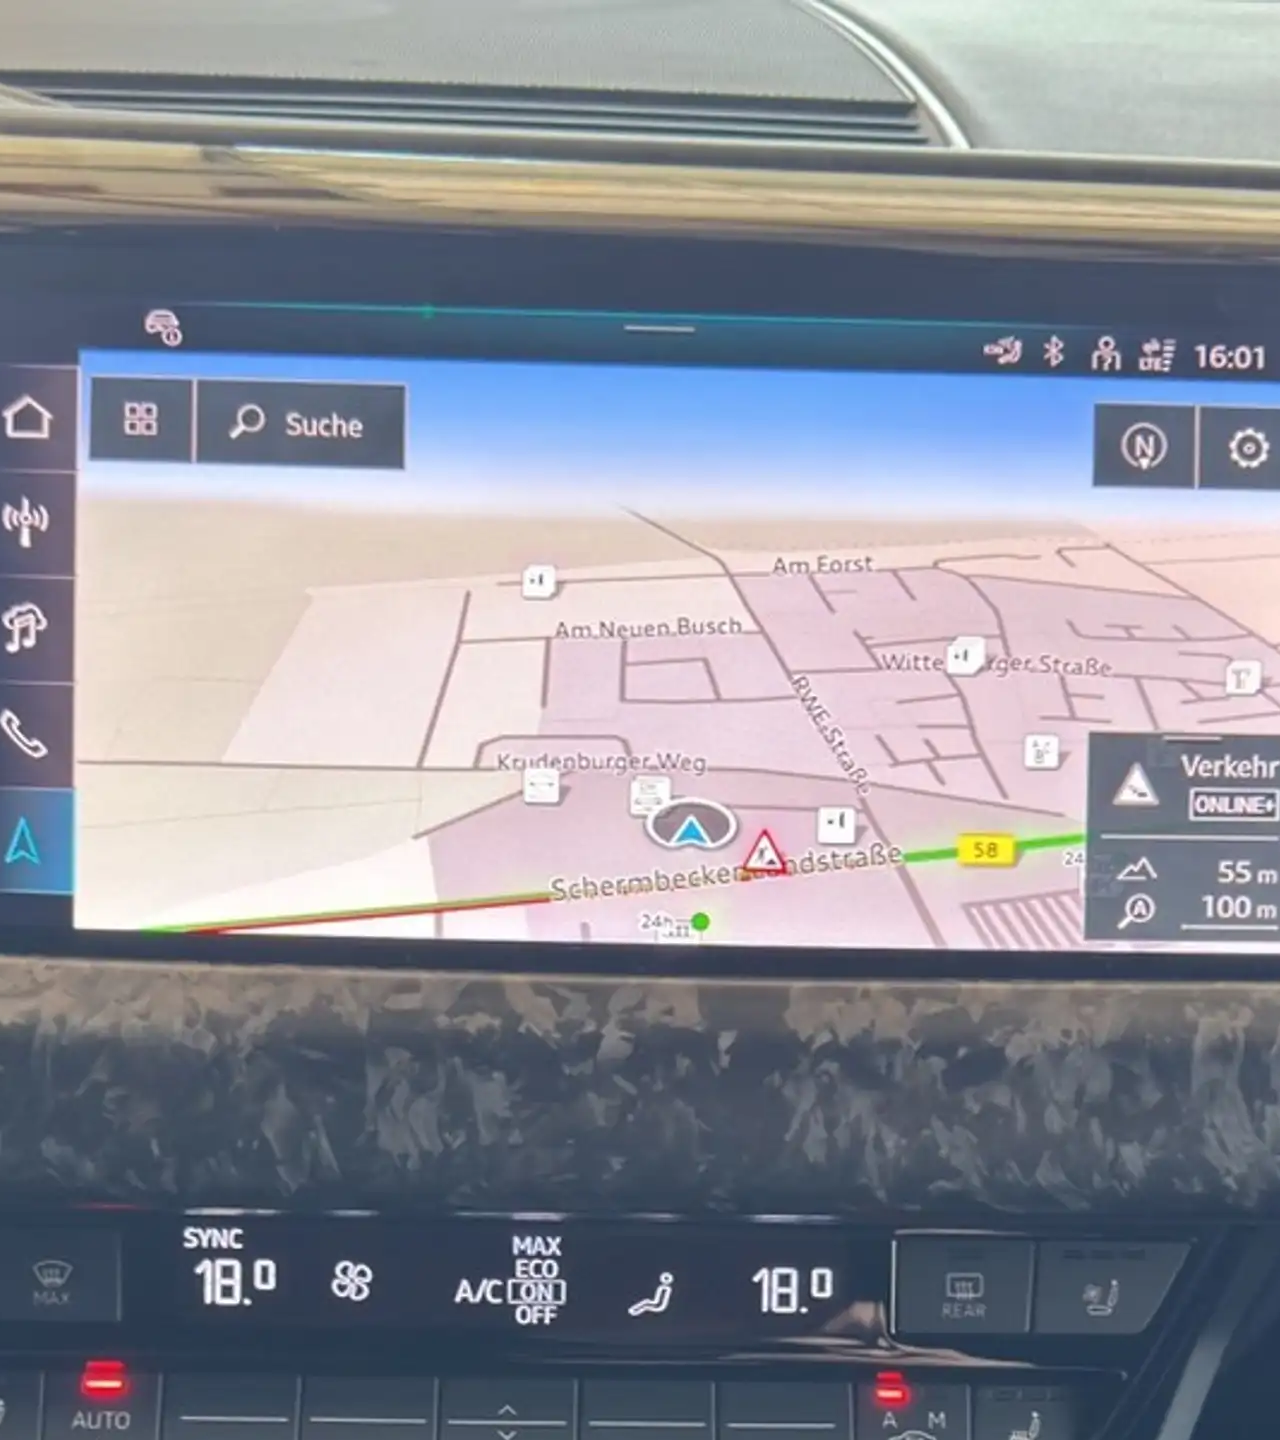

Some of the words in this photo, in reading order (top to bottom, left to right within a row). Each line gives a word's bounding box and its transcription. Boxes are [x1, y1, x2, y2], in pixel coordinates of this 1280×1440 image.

[1194, 344, 1267, 370] 16:01
[285, 412, 364, 440] Suche
[773, 557, 810, 575] Am
[817, 555, 874, 574] Forst
[555, 621, 592, 639] Am
[599, 619, 669, 638] Neuen
[677, 617, 743, 636] Busch
[1038, 654, 1113, 677] Straße
[657, 752, 707, 775] Weg
[1194, 793, 1278, 814] ONLINE+
[972, 841, 1000, 859] 58
[751, 842, 903, 882] ndstraße
[1217, 860, 1252, 884] 55
[1256, 868, 1280, 885] m
[1201, 894, 1252, 919] 100
[1256, 902, 1280, 919] m
[641, 912, 673, 930] 24h
[183, 1227, 246, 1250] SYNC
[511, 1235, 563, 1257] MAX
[515, 1258, 560, 1279] ECO
[32, 1289, 71, 1306] MAX
[454, 1277, 505, 1305] A/C
[520, 1282, 555, 1302] ON
[514, 1304, 559, 1326] OFF
[941, 1303, 988, 1321] REAR
[70, 1410, 132, 1430] AUTO
[881, 1411, 899, 1429] A
[926, 1410, 948, 1430] M
